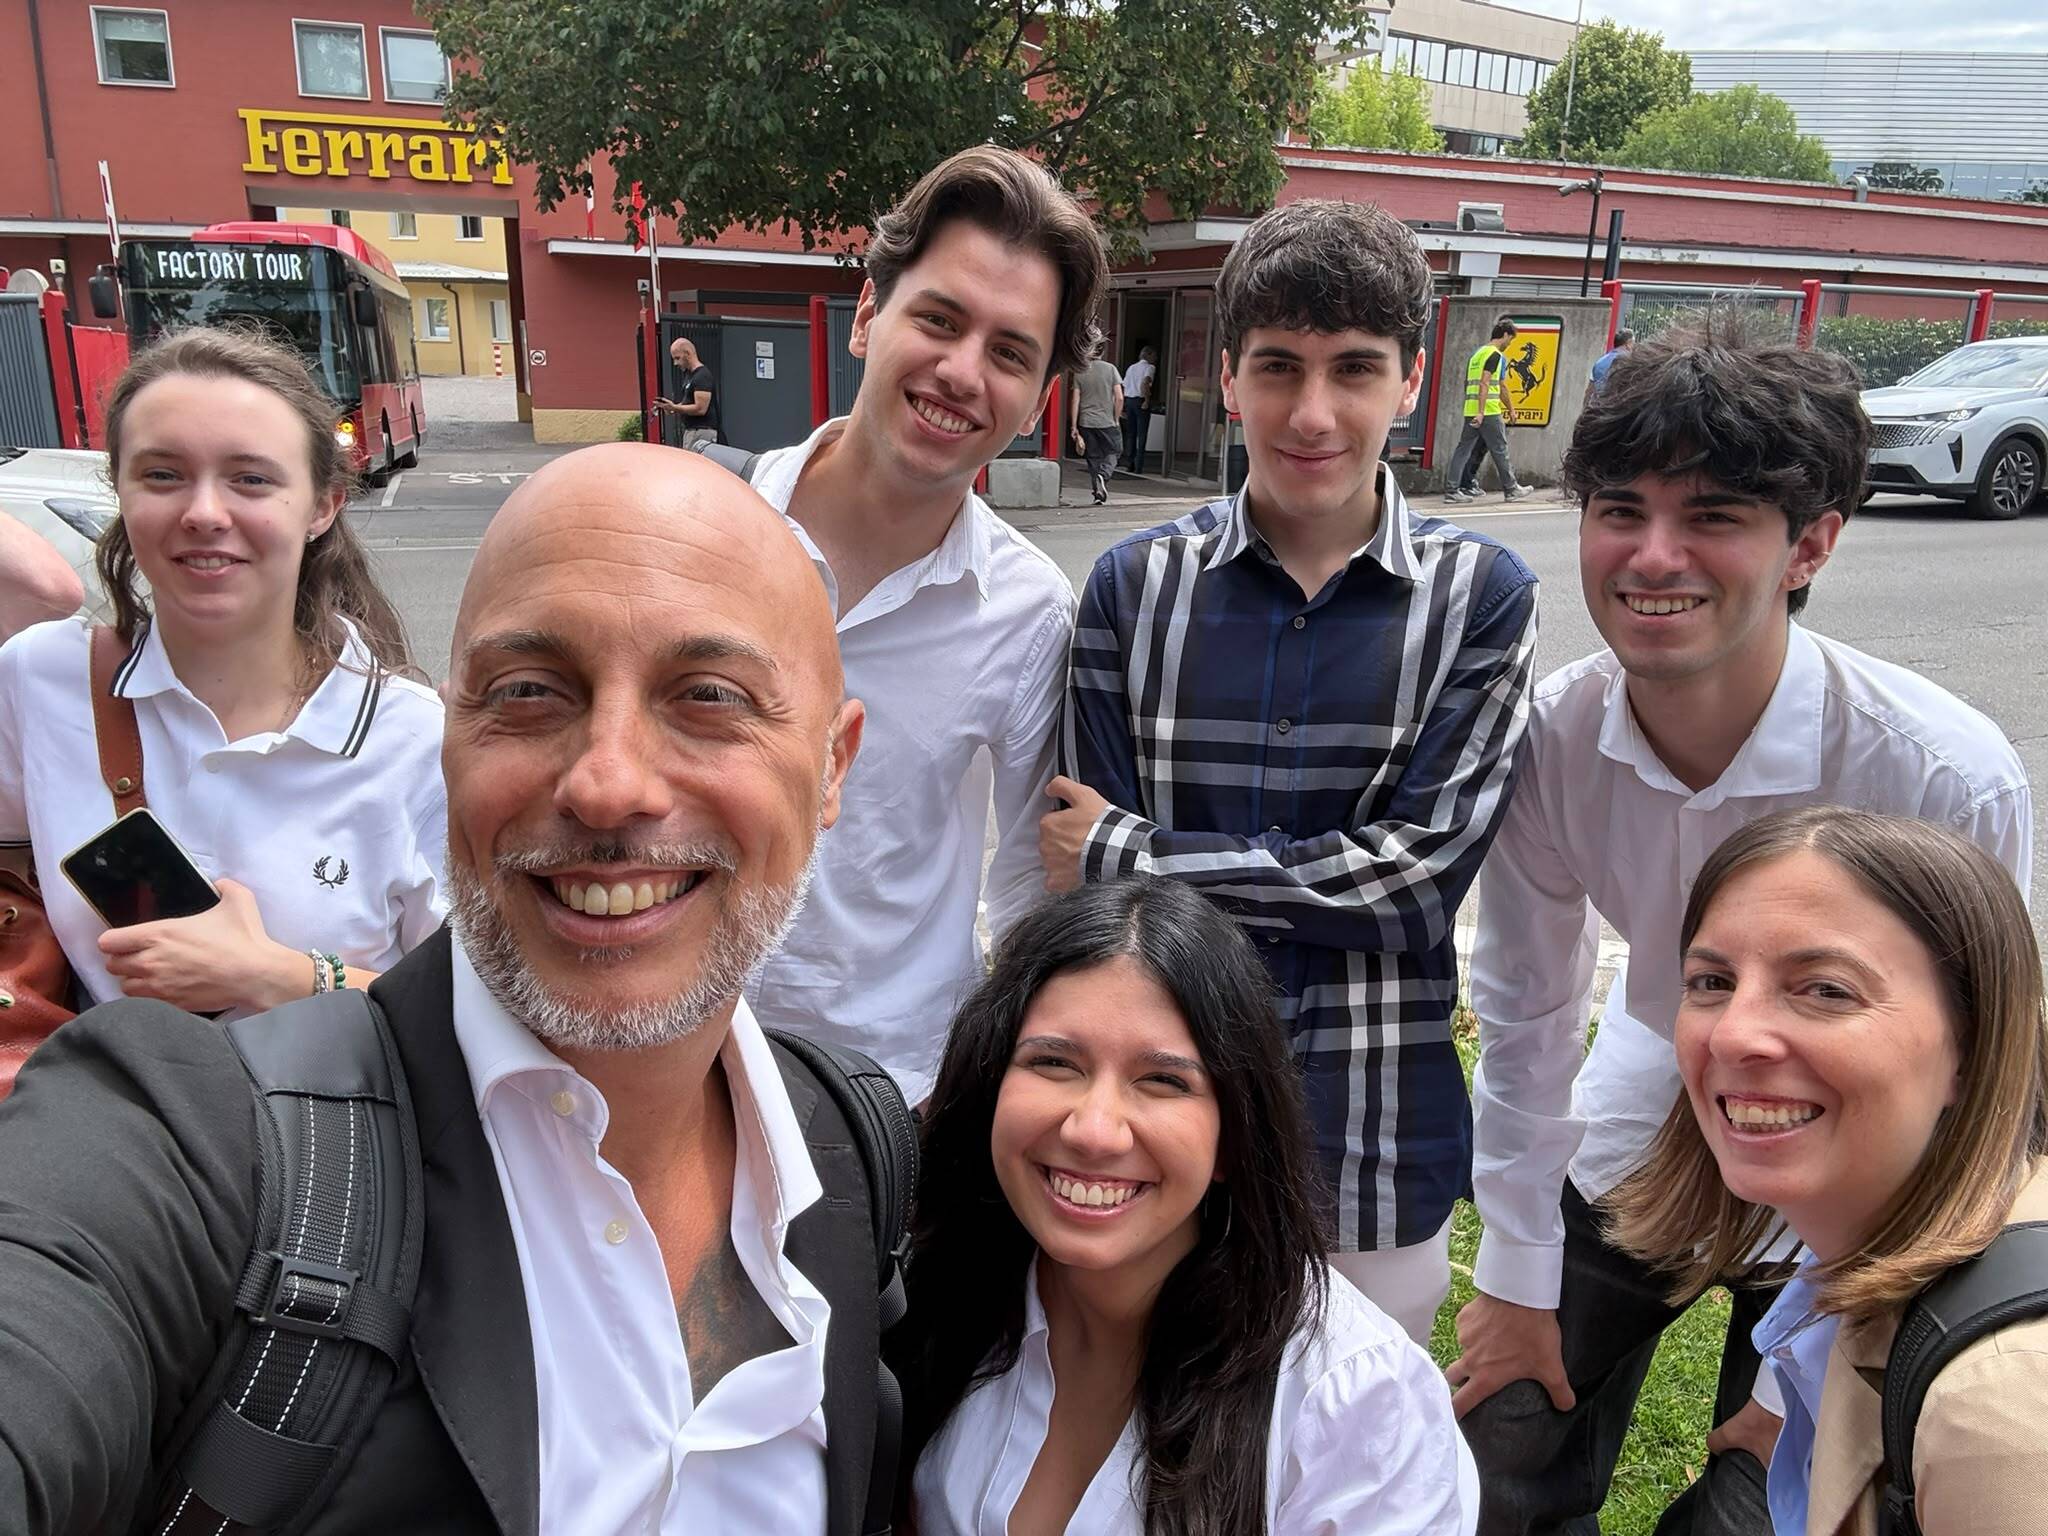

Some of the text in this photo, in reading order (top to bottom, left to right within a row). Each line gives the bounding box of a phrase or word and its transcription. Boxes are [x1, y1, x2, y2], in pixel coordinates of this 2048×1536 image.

[238, 108, 514, 185] Ferrari
[157, 250, 304, 281] FACTORY TOUR
[1501, 407, 1544, 421] erari
